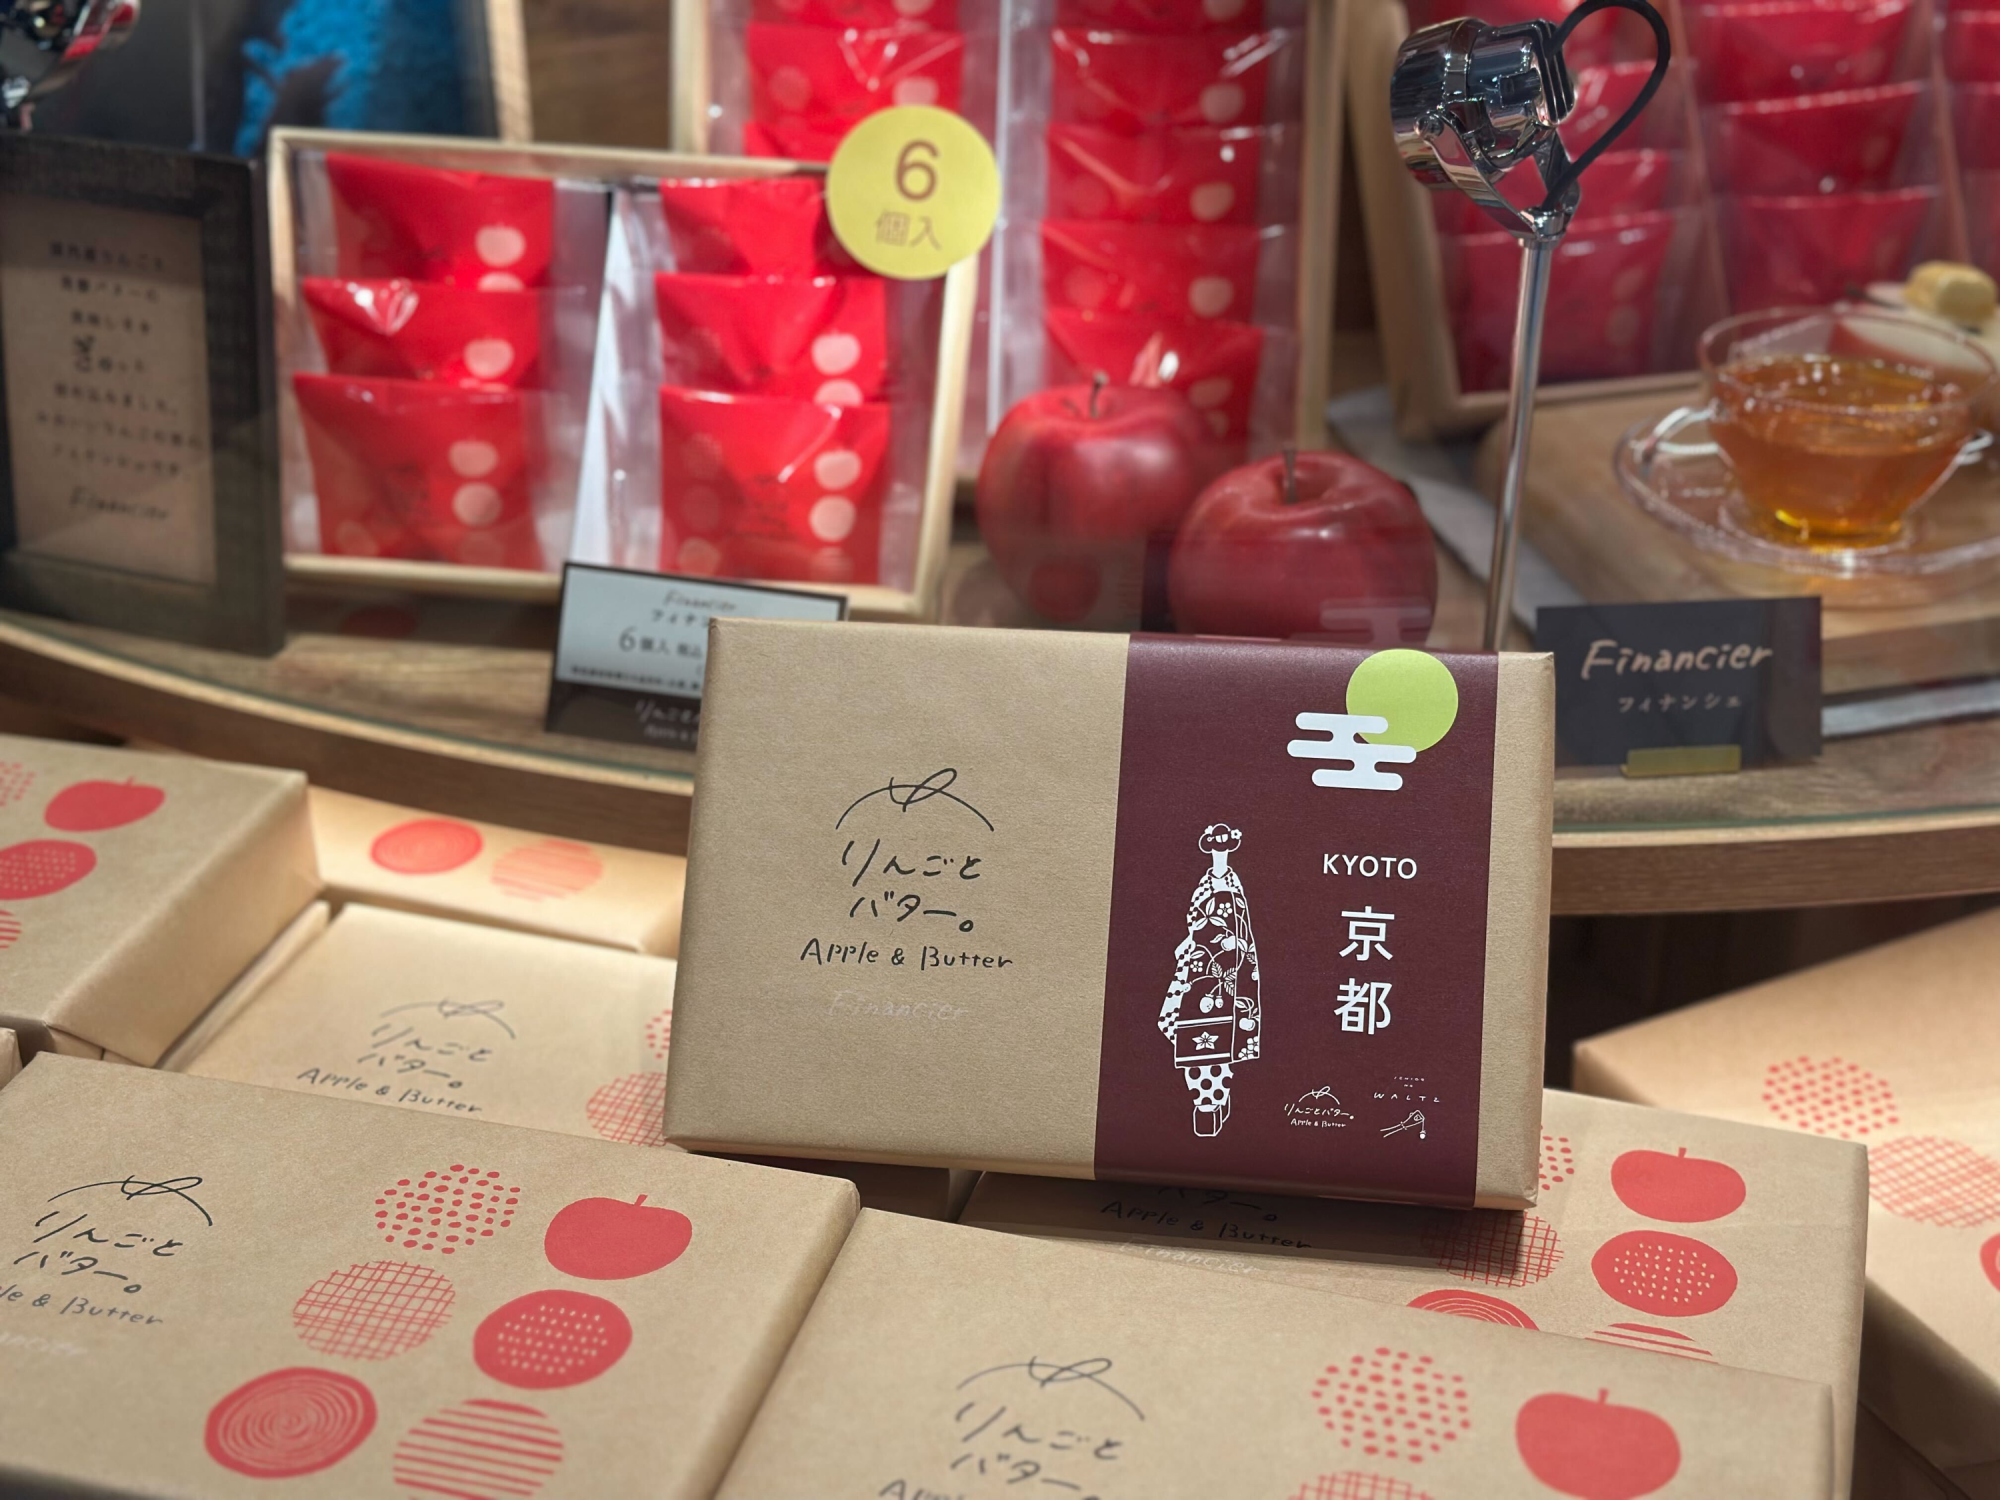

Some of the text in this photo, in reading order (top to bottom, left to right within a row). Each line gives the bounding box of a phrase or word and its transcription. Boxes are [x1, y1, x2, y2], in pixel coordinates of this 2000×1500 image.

[895, 139, 939, 202] 6
[875, 209, 943, 251] 個入
[1580, 638, 1773, 680] Financier
[1618, 692, 1741, 713] フィナンシェ
[841, 838, 982, 887] りんごと
[1323, 853, 1418, 880] KYOTO
[849, 890, 974, 932] バター。
[800, 937, 1013, 971] Apple & Butter
[1333, 905, 1396, 1035] 京都
[827, 989, 968, 1021] Financier
[371, 1023, 493, 1062] りんごと
[297, 1067, 483, 1114] Apple & Butter
[357, 1053, 463, 1090] バター。
[33, 1210, 184, 1258] りんごと
[1101, 1201, 1312, 1249] Apple & Butter
[13, 1250, 142, 1294] バター。
[32, 1293, 52, 1308] &
[59, 1296, 164, 1325] Butter
[955, 1401, 1123, 1460] りんごと
